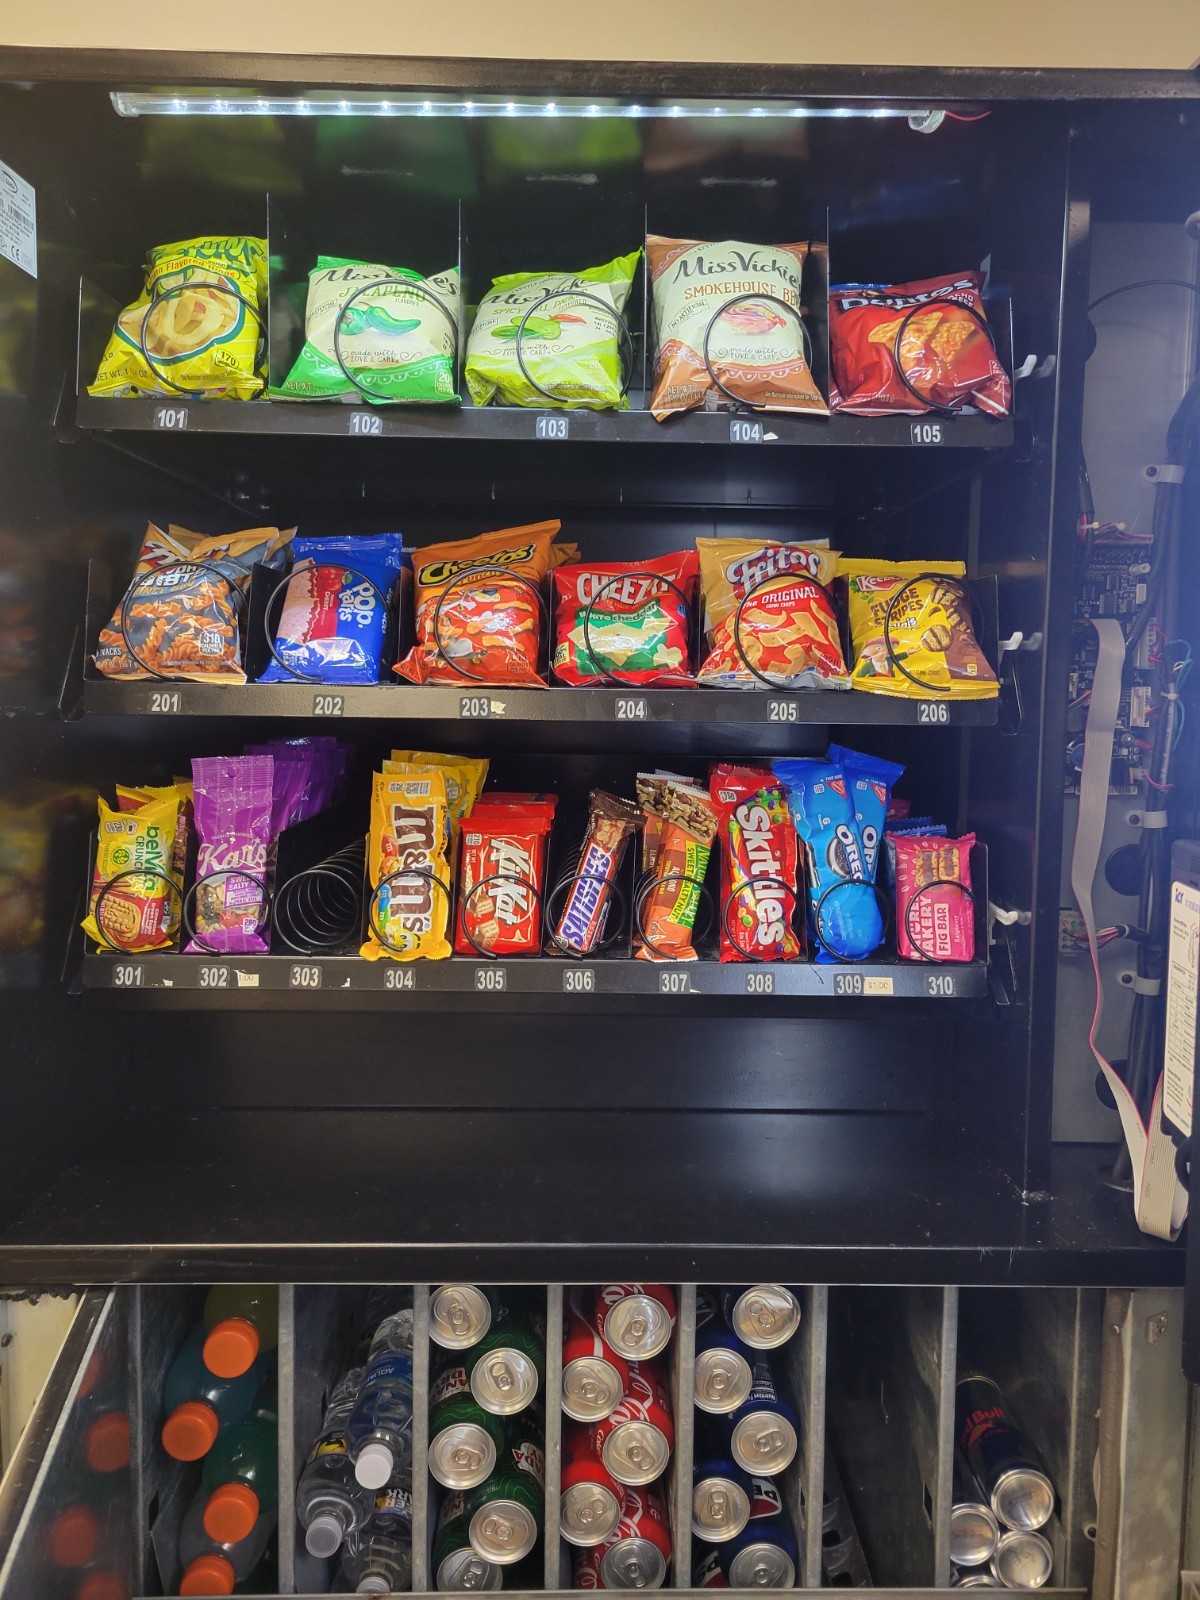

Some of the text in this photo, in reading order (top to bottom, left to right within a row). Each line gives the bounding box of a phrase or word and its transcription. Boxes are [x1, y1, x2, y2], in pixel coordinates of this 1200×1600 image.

[166, 259, 205, 271] Flavored
[672, 250, 801, 291] Miss Vickie'
[684, 281, 777, 300] SMOKEHOUSE
[220, 351, 236, 367] 170
[350, 355, 367, 364] LOVE
[376, 355, 395, 364] CARE
[374, 348, 398, 357] with
[729, 346, 778, 355] made with
[729, 352, 749, 361] LOVE
[758, 353, 776, 361] CARE
[157, 409, 186, 428] 101
[352, 415, 380, 433] 102
[539, 421, 566, 437] 103
[733, 423, 760, 441] 104
[913, 425, 941, 443] 105
[420, 545, 534, 584] Cheetos
[727, 547, 820, 594] Fritos
[761, 587, 820, 604] ORIGINAL
[338, 589, 352, 622] tarts
[611, 601, 658, 622] cheddar
[203, 632, 221, 644] 310
[151, 694, 179, 712] 201
[314, 696, 342, 715] 202
[461, 698, 489, 716] 203
[617, 701, 645, 719] 204
[770, 702, 797, 721] 205
[920, 704, 947, 722] 206
[686, 847, 696, 875] SWEET
[669, 865, 681, 893] ALOND
[736, 804, 786, 945] Skittles
[228, 881, 249, 891] SALTY
[669, 904, 684, 923] NUT
[937, 907, 949, 952] FIG BAR
[953, 914, 961, 943] Raspberry
[114, 967, 142, 986] 301
[200, 967, 227, 987] 302
[291, 967, 320, 987] 303
[385, 970, 413, 989] 304
[477, 971, 504, 990] 305
[566, 972, 592, 990] 306
[661, 974, 688, 992] 307
[747, 974, 773, 992] 308
[836, 975, 862, 994] 309
[928, 976, 953, 995] 310
[973, 1407, 1007, 1424] Bull
